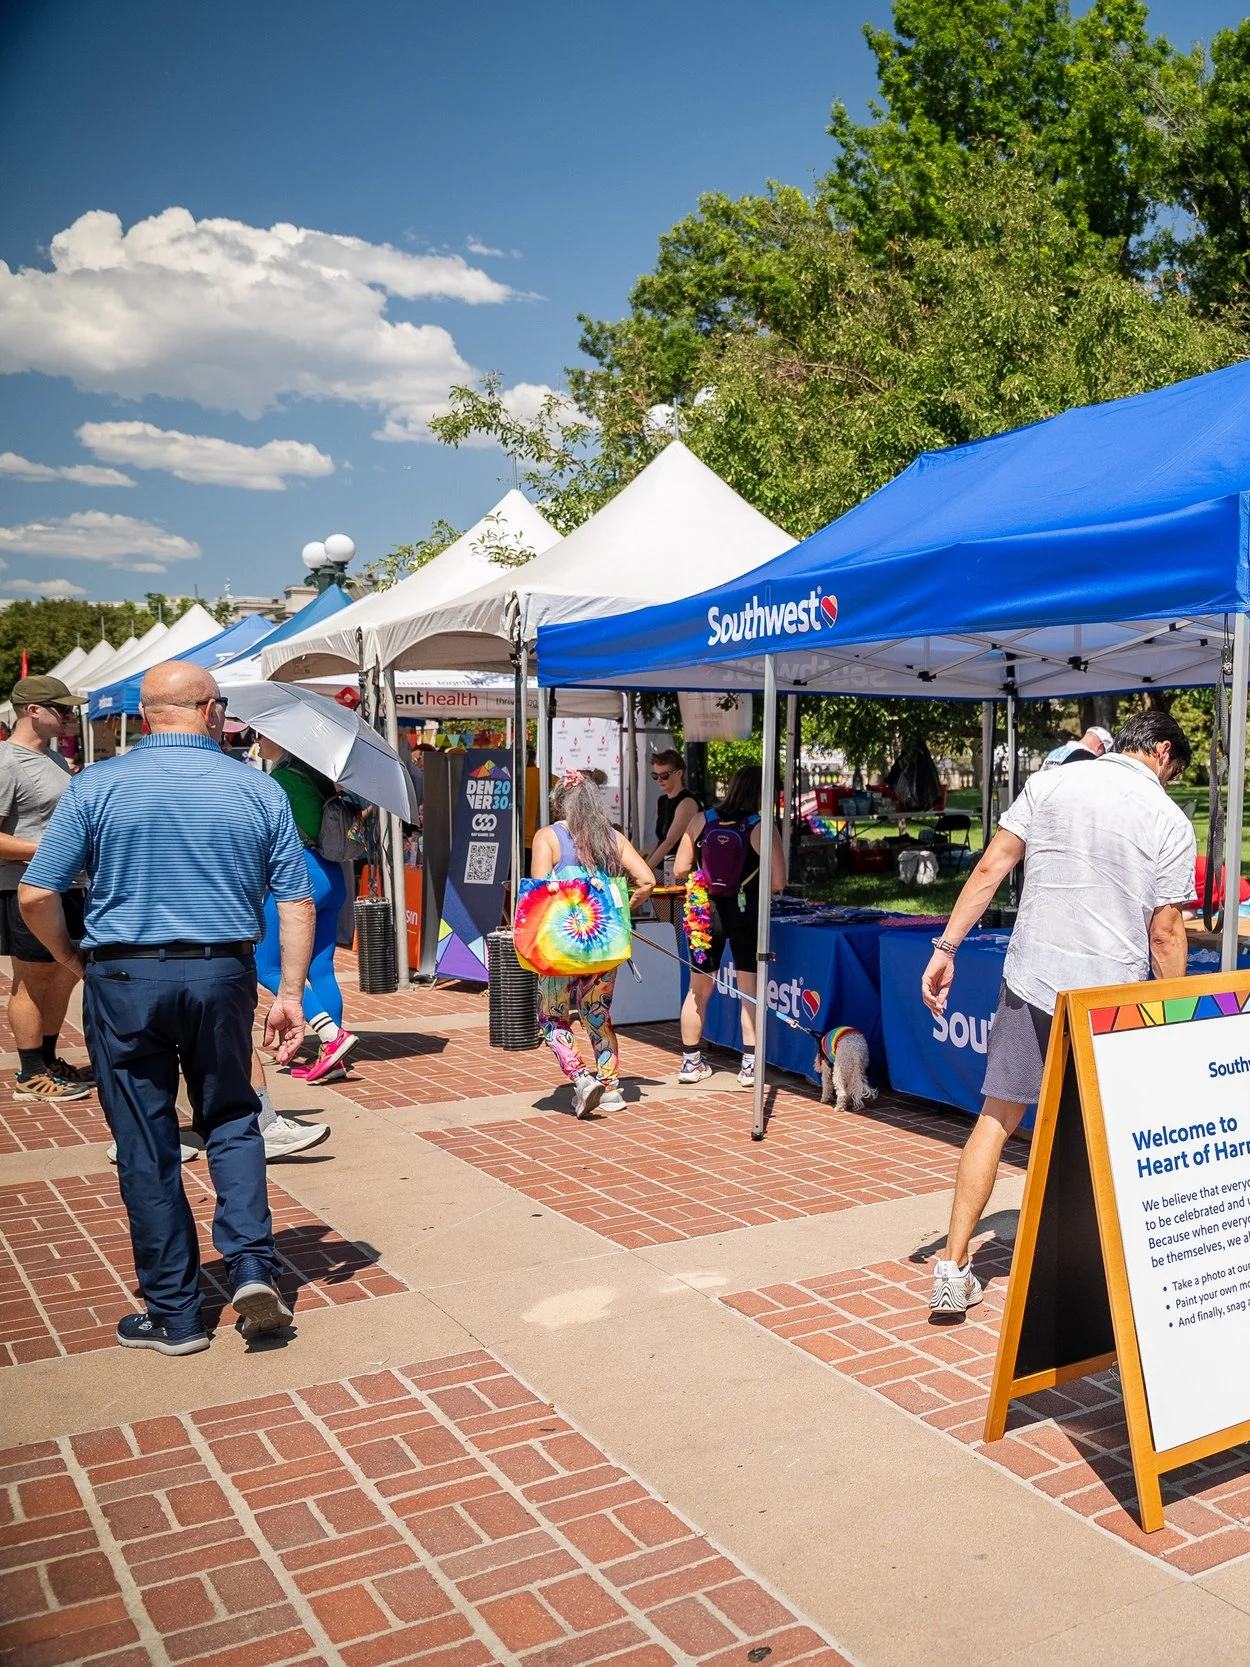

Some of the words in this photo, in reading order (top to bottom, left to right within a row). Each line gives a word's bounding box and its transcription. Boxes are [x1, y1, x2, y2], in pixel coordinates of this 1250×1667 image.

[707, 590, 821, 646] Southwest
[395, 691, 478, 706] enthealth
[496, 697, 514, 705] thriv
[716, 961, 801, 1018] utest
[1132, 1122, 1217, 1151] Welcome
[1219, 1115, 1239, 1134] to
[1137, 1151, 1190, 1179] Heart
[1193, 1143, 1211, 1166] of
[1142, 1200, 1160, 1213] We
[1162, 1192, 1198, 1208] believe
[1200, 1186, 1220, 1199] that
[1145, 1221, 1157, 1231] to
[1158, 1216, 1172, 1228] be
[1174, 1201, 1225, 1224] celebrated
[1228, 1196, 1245, 1211] and
[1149, 1232, 1190, 1250] Because
[1192, 1224, 1220, 1238] when
[1151, 1257, 1165, 1268] be
[1166, 1242, 1226, 1264] themselves,
[1227, 1237, 1242, 1248] we
[1172, 1279, 1193, 1291] Take
[1195, 1278, 1200, 1286] a
[1201, 1270, 1226, 1286] photo
[1228, 1267, 1236, 1276] at
[1237, 1263, 1250, 1273] our
[1176, 1296, 1198, 1309] Paint
[1199, 1290, 1218, 1305] your
[1220, 1285, 1238, 1297] own
[1179, 1313, 1196, 1328] And
[1197, 1307, 1226, 1322] finally,
[1226, 1301, 1246, 1313] snag
